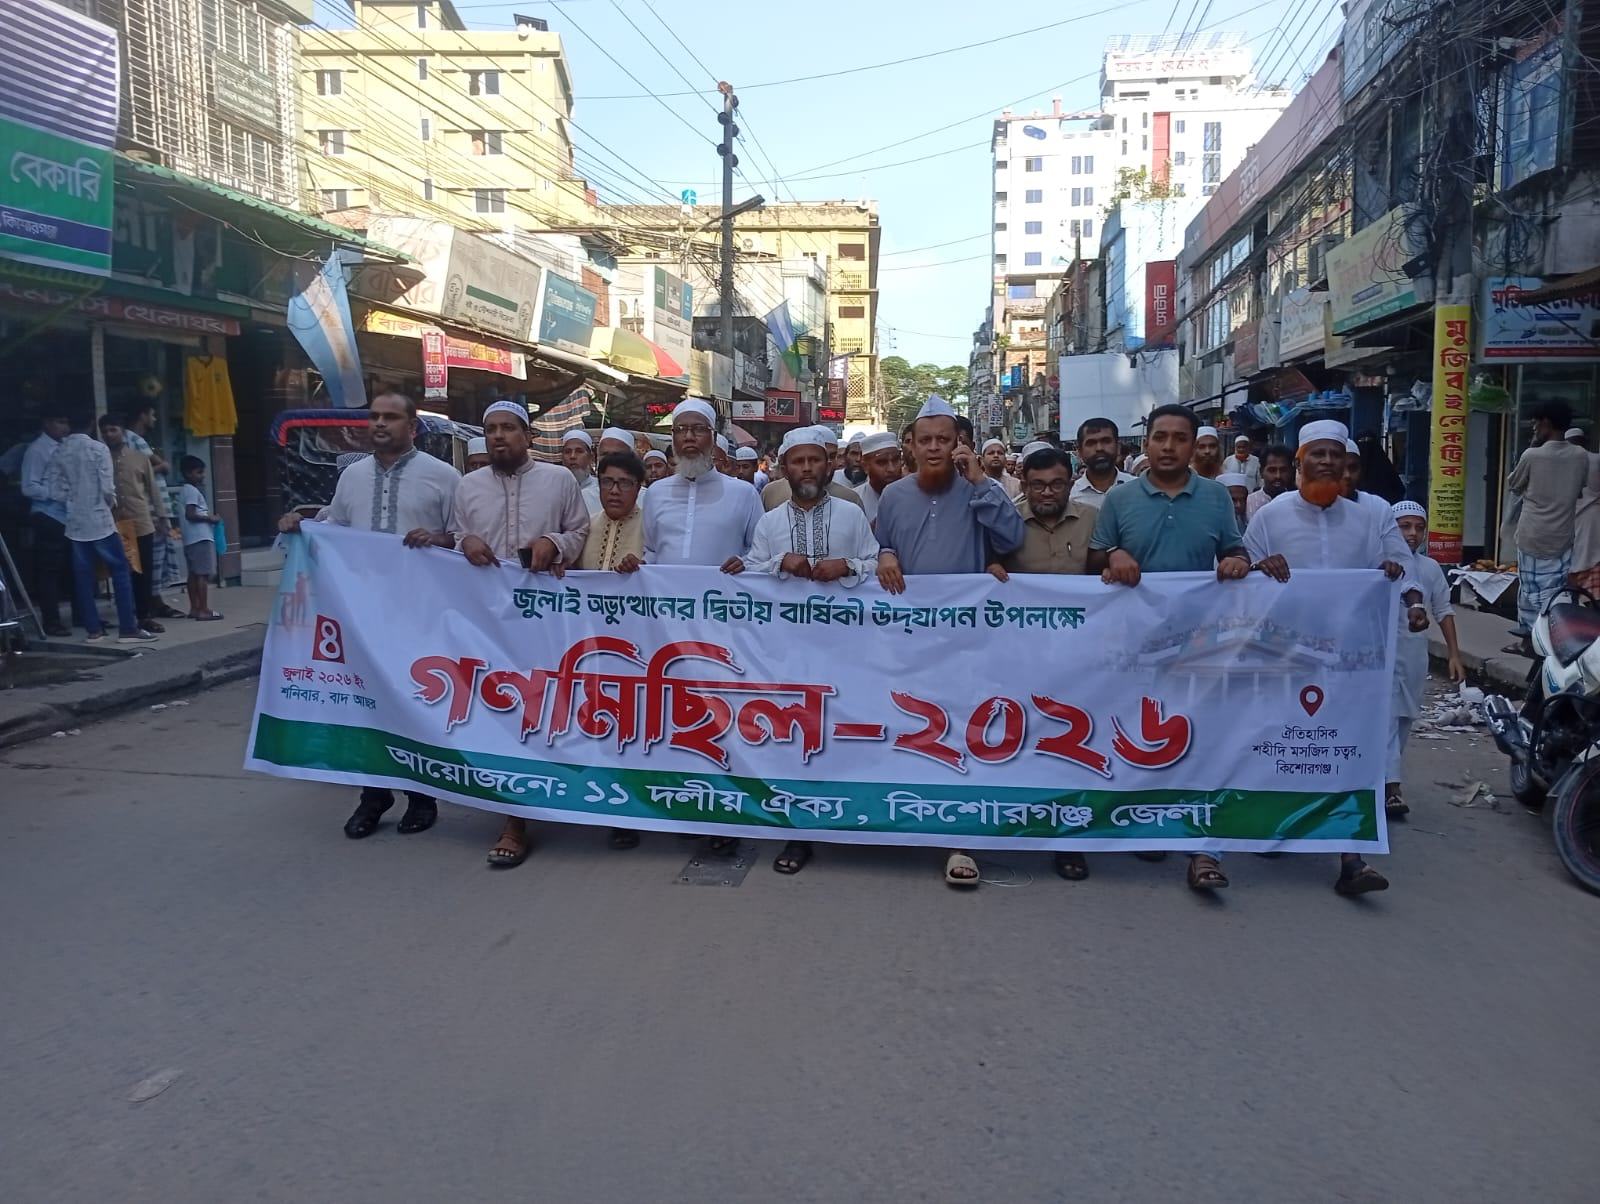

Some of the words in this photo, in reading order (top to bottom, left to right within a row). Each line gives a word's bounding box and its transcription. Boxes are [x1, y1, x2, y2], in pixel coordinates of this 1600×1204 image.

[11, 151, 102, 203] বেকারি
[513, 586, 582, 620] জুলাই
[588, 593, 697, 625] অভ্যুত্থানের
[703, 589, 773, 625] দ্বিতীয়
[780, 595, 864, 626] বার্ষিকী
[984, 599, 1086, 630] উপলক্ষে
[318, 620, 342, 660] ৪
[282, 666, 315, 683] জুলাই
[318, 671, 352, 687] ২০২৬
[329, 692, 349, 705] বাদ
[1282, 725, 1339, 741] ঐতিহাসিক
[1252, 741, 1286, 758] শহীদি
[1290, 743, 1330, 758] মসজিদ
[584, 779, 629, 805] ১১
[645, 779, 750, 814] দলীয়
[760, 784, 852, 820] ঐক্য
[883, 790, 1094, 828] কিশোরগঞ্জ
[1110, 801, 1219, 828] জেলা
